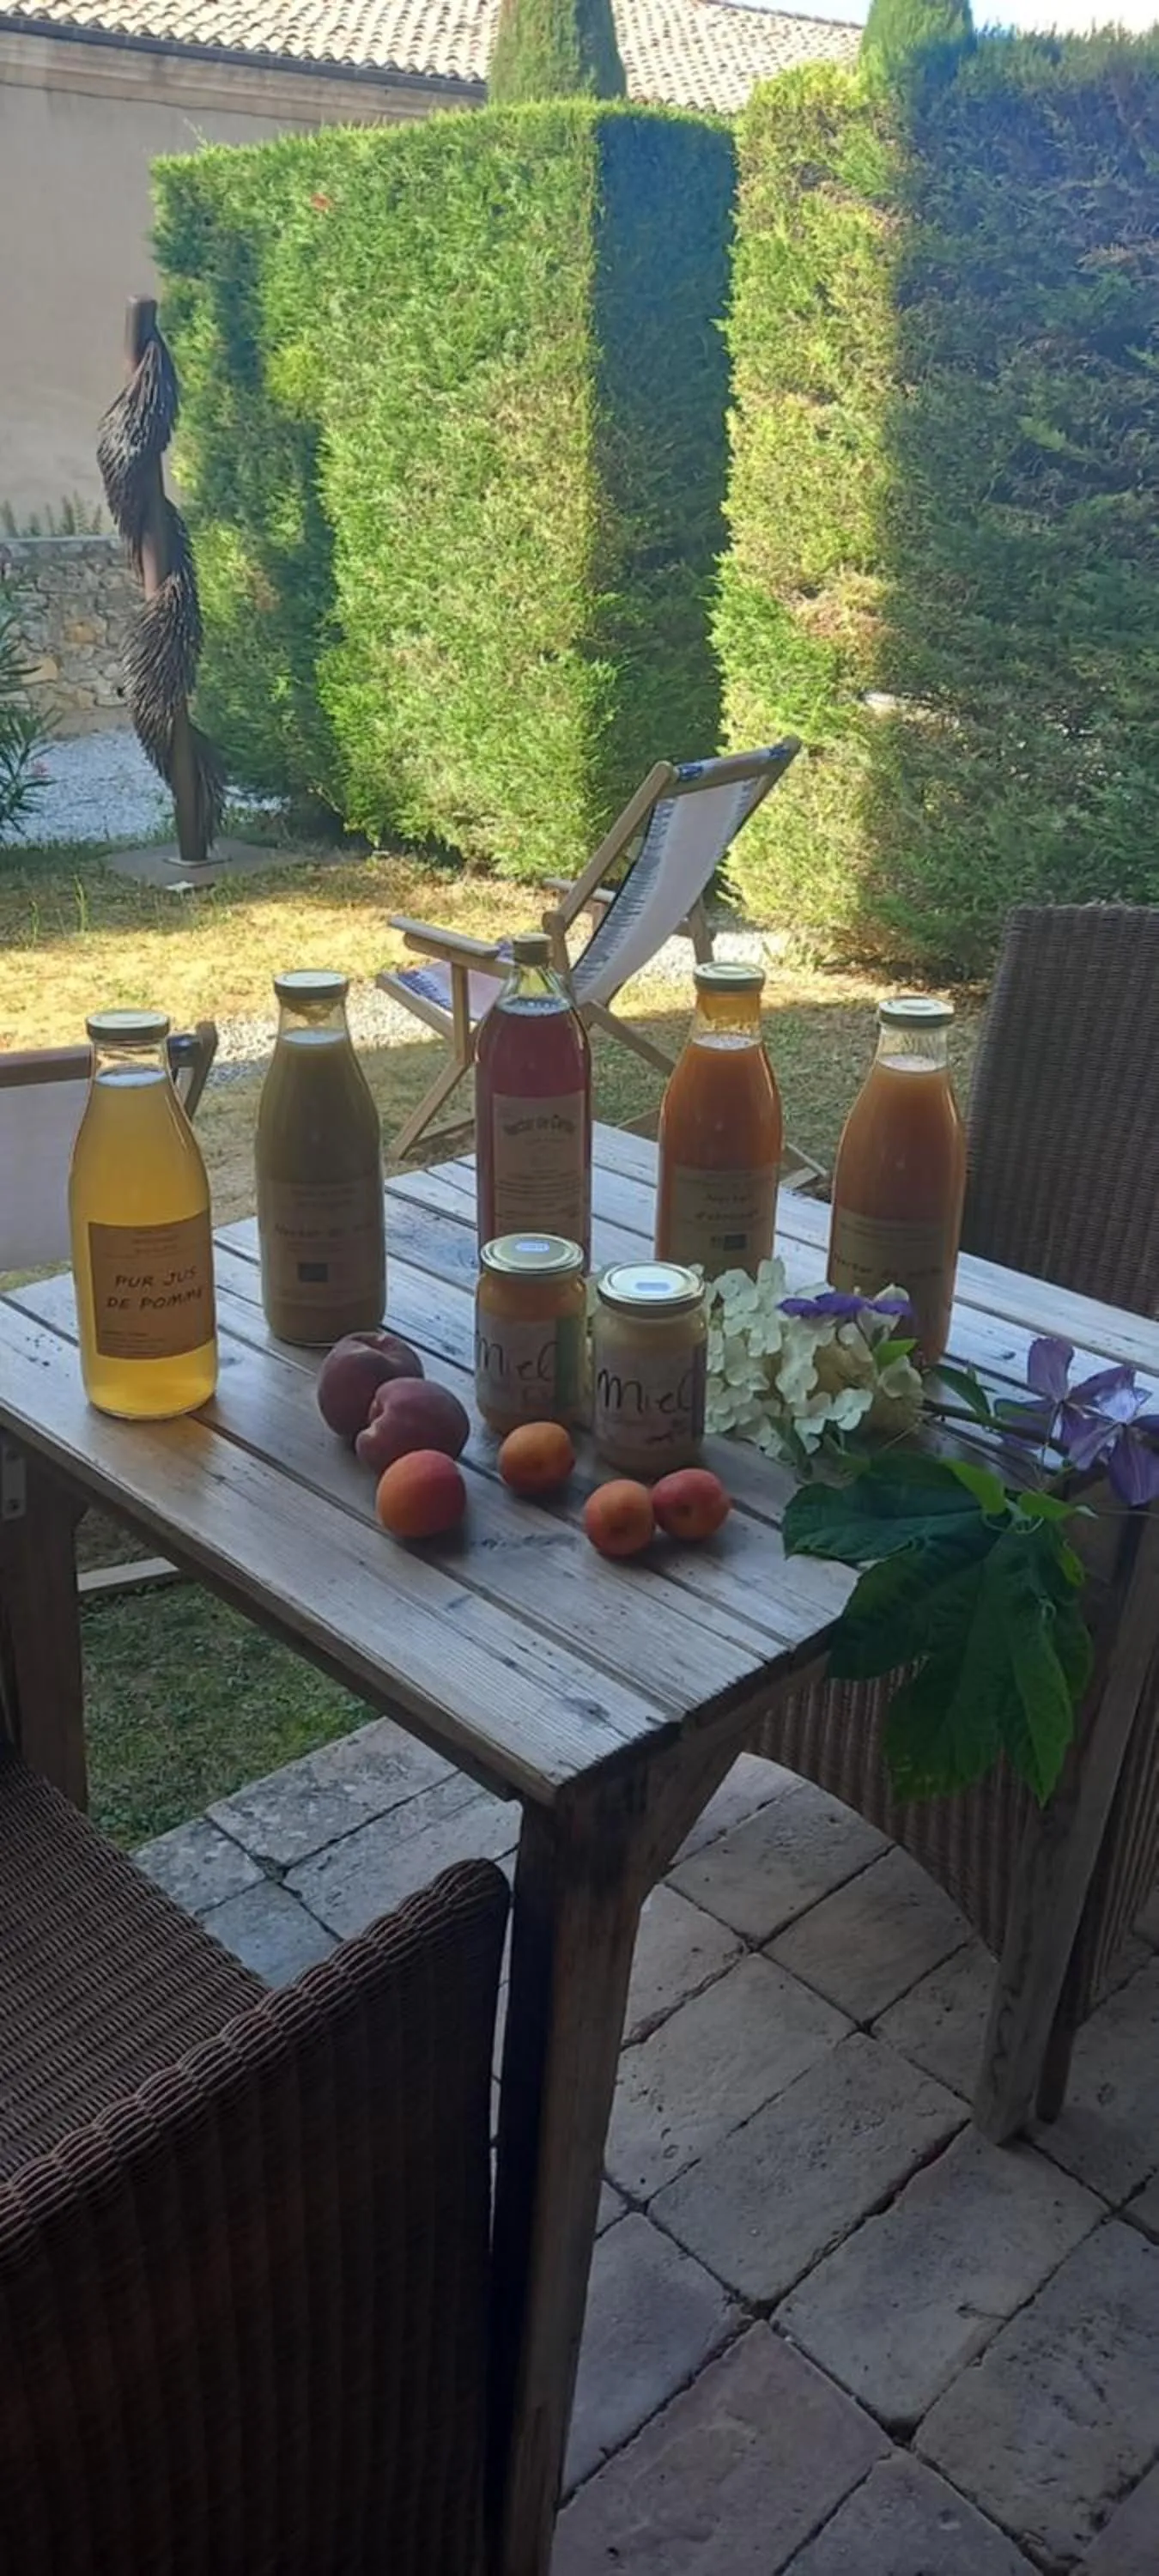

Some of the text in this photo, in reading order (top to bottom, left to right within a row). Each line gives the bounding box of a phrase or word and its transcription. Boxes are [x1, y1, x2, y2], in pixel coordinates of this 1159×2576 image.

[115, 1266, 197, 1288] PUR JUS
[106, 1296, 130, 1309] DE
[597, 1368, 697, 1415] Miel
